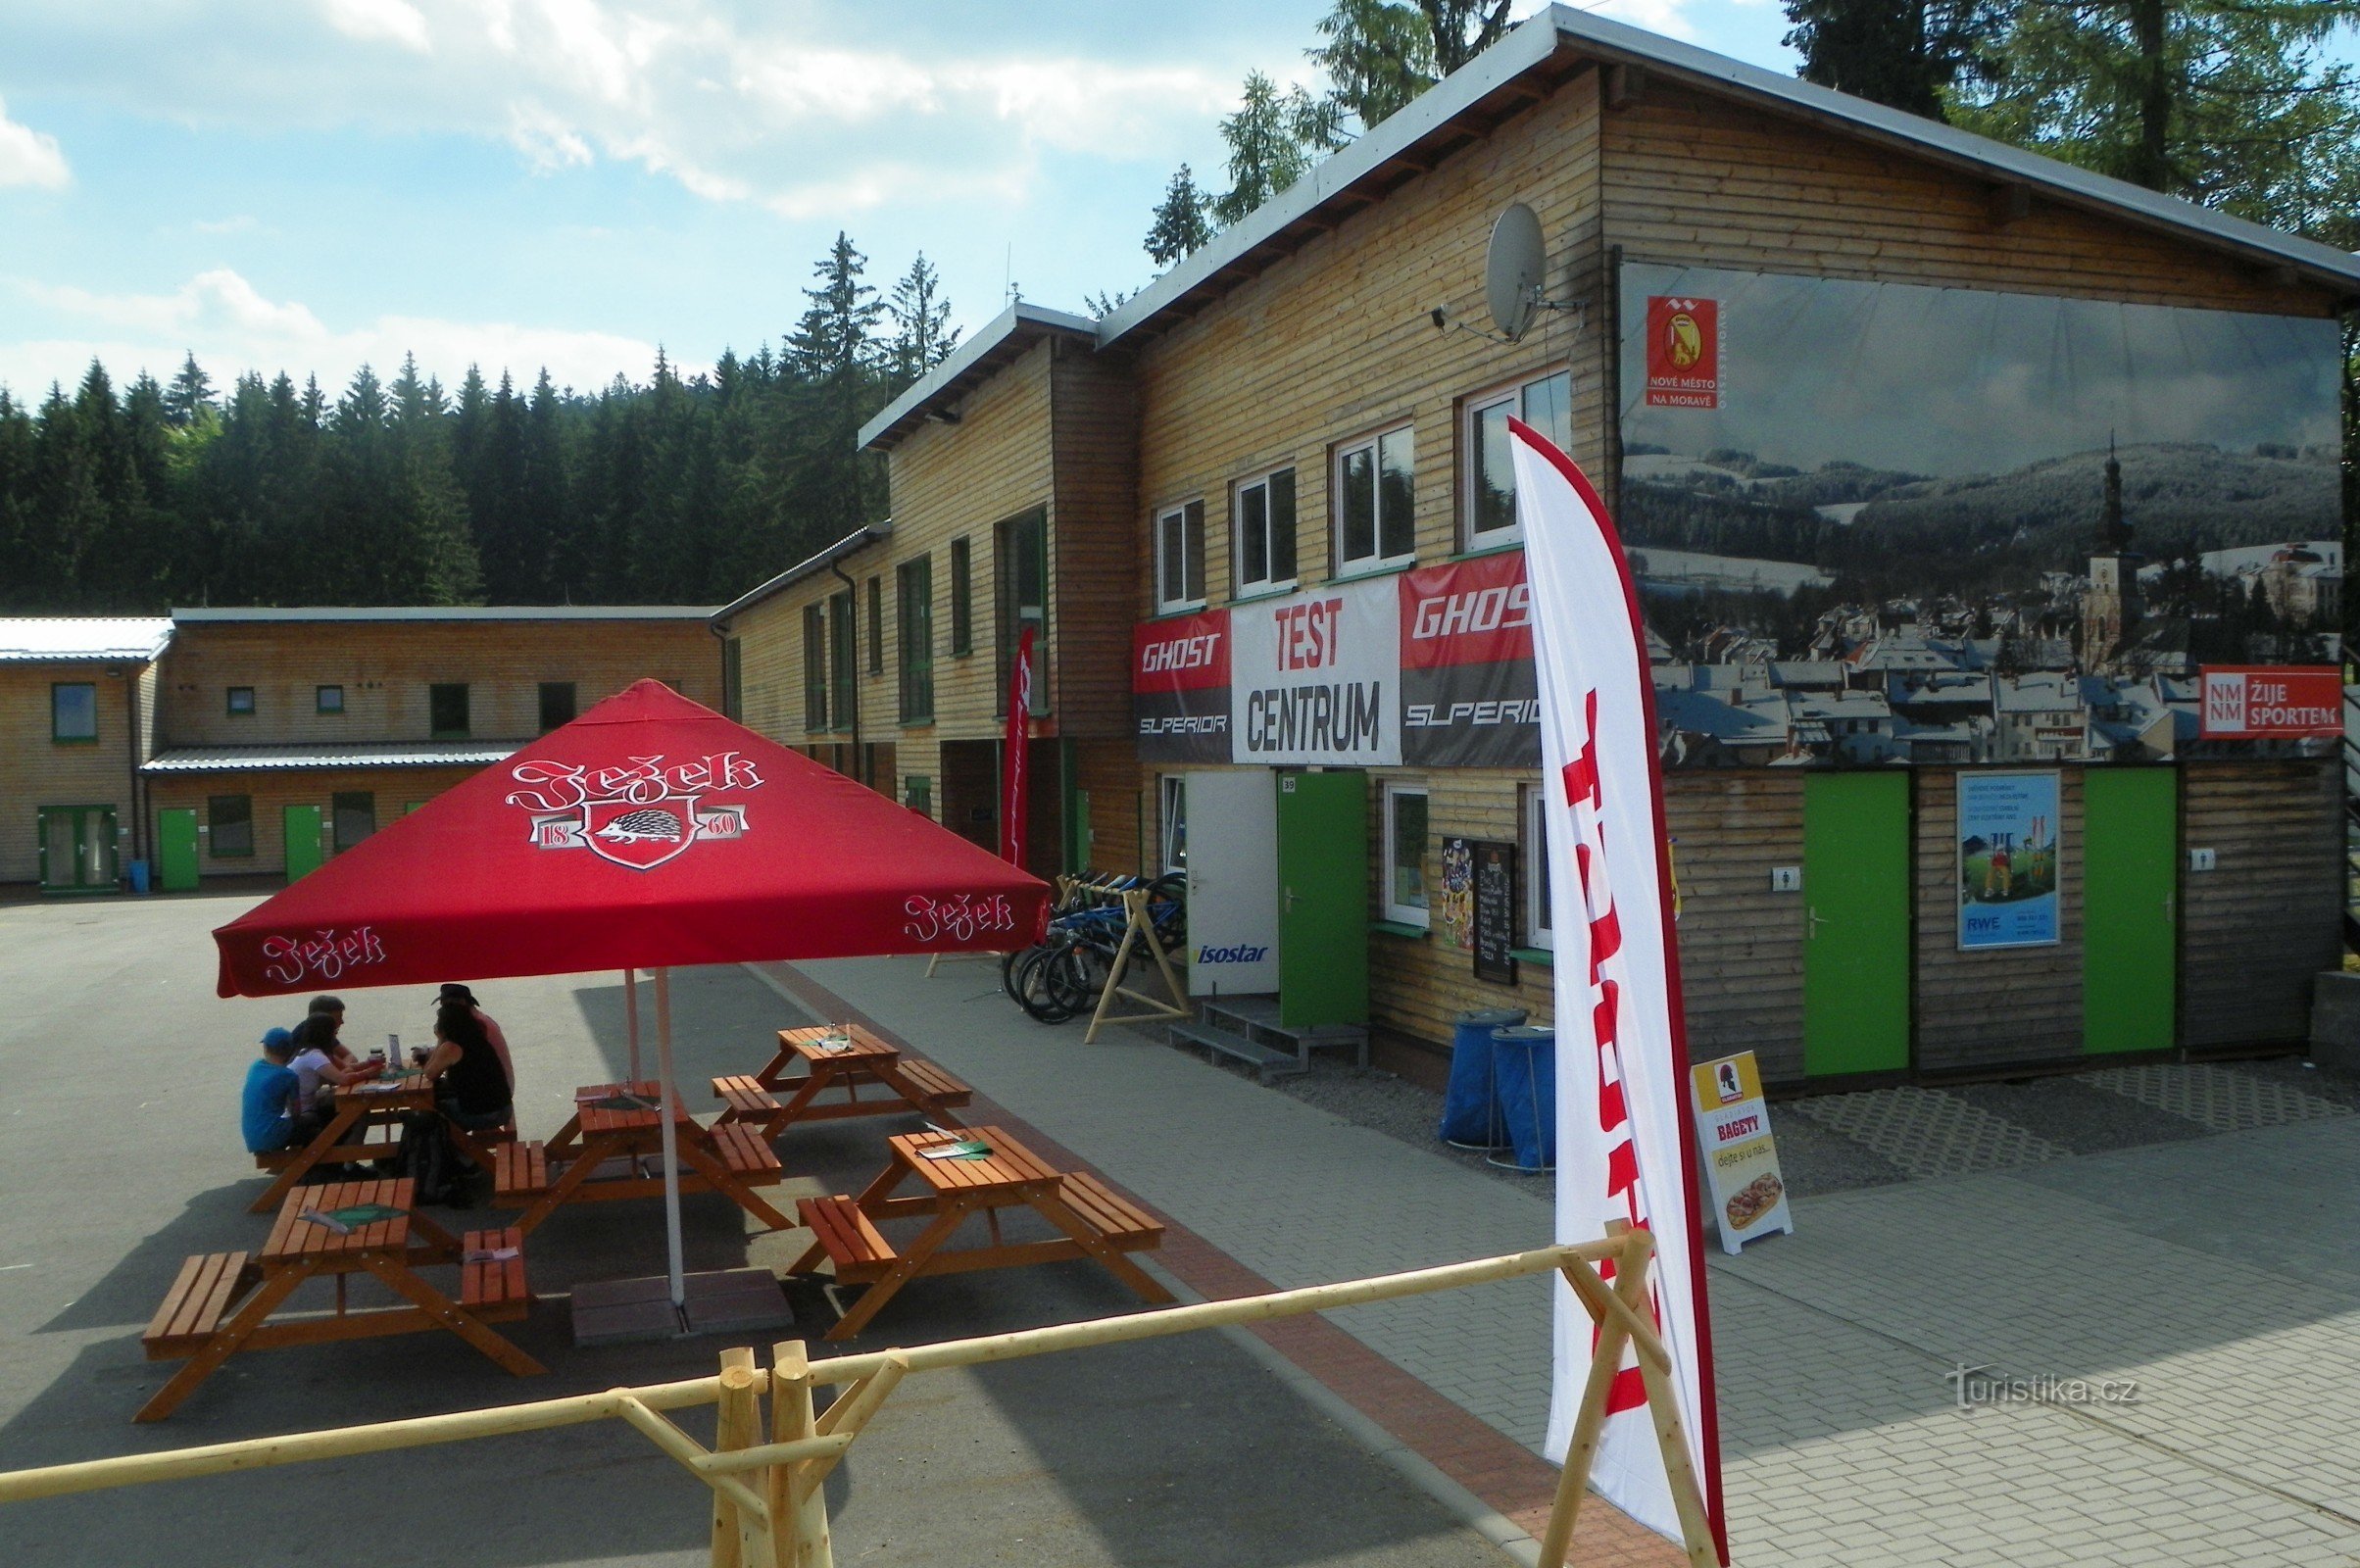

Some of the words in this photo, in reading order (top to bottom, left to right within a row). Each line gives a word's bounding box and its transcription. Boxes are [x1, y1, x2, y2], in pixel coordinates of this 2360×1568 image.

[1649, 376, 1678, 387] NOVÉ
[1681, 377, 1716, 389] MĚSTO
[1652, 394, 1667, 404] NA
[1669, 395, 1712, 407] MORAVĚ
[1275, 598, 1343, 671] TEST
[1142, 633, 1222, 673] GHOST
[2210, 683, 2241, 702] NM
[2250, 680, 2288, 707] ŽIJE
[1248, 681, 1380, 752] CENTRUM
[2210, 703, 2241, 721] NM
[2250, 707, 2336, 726] SPORTEM
[1283, 780, 1295, 790] 39
[540, 823, 570, 847] 18
[706, 812, 736, 835] 60
[1967, 916, 2001, 932] RWE
[1198, 944, 1268, 964] isostar
[1717, 1115, 1759, 1142] BAGETY
[1718, 1152, 1739, 1168] dejte
[1746, 1148, 1752, 1157] u
